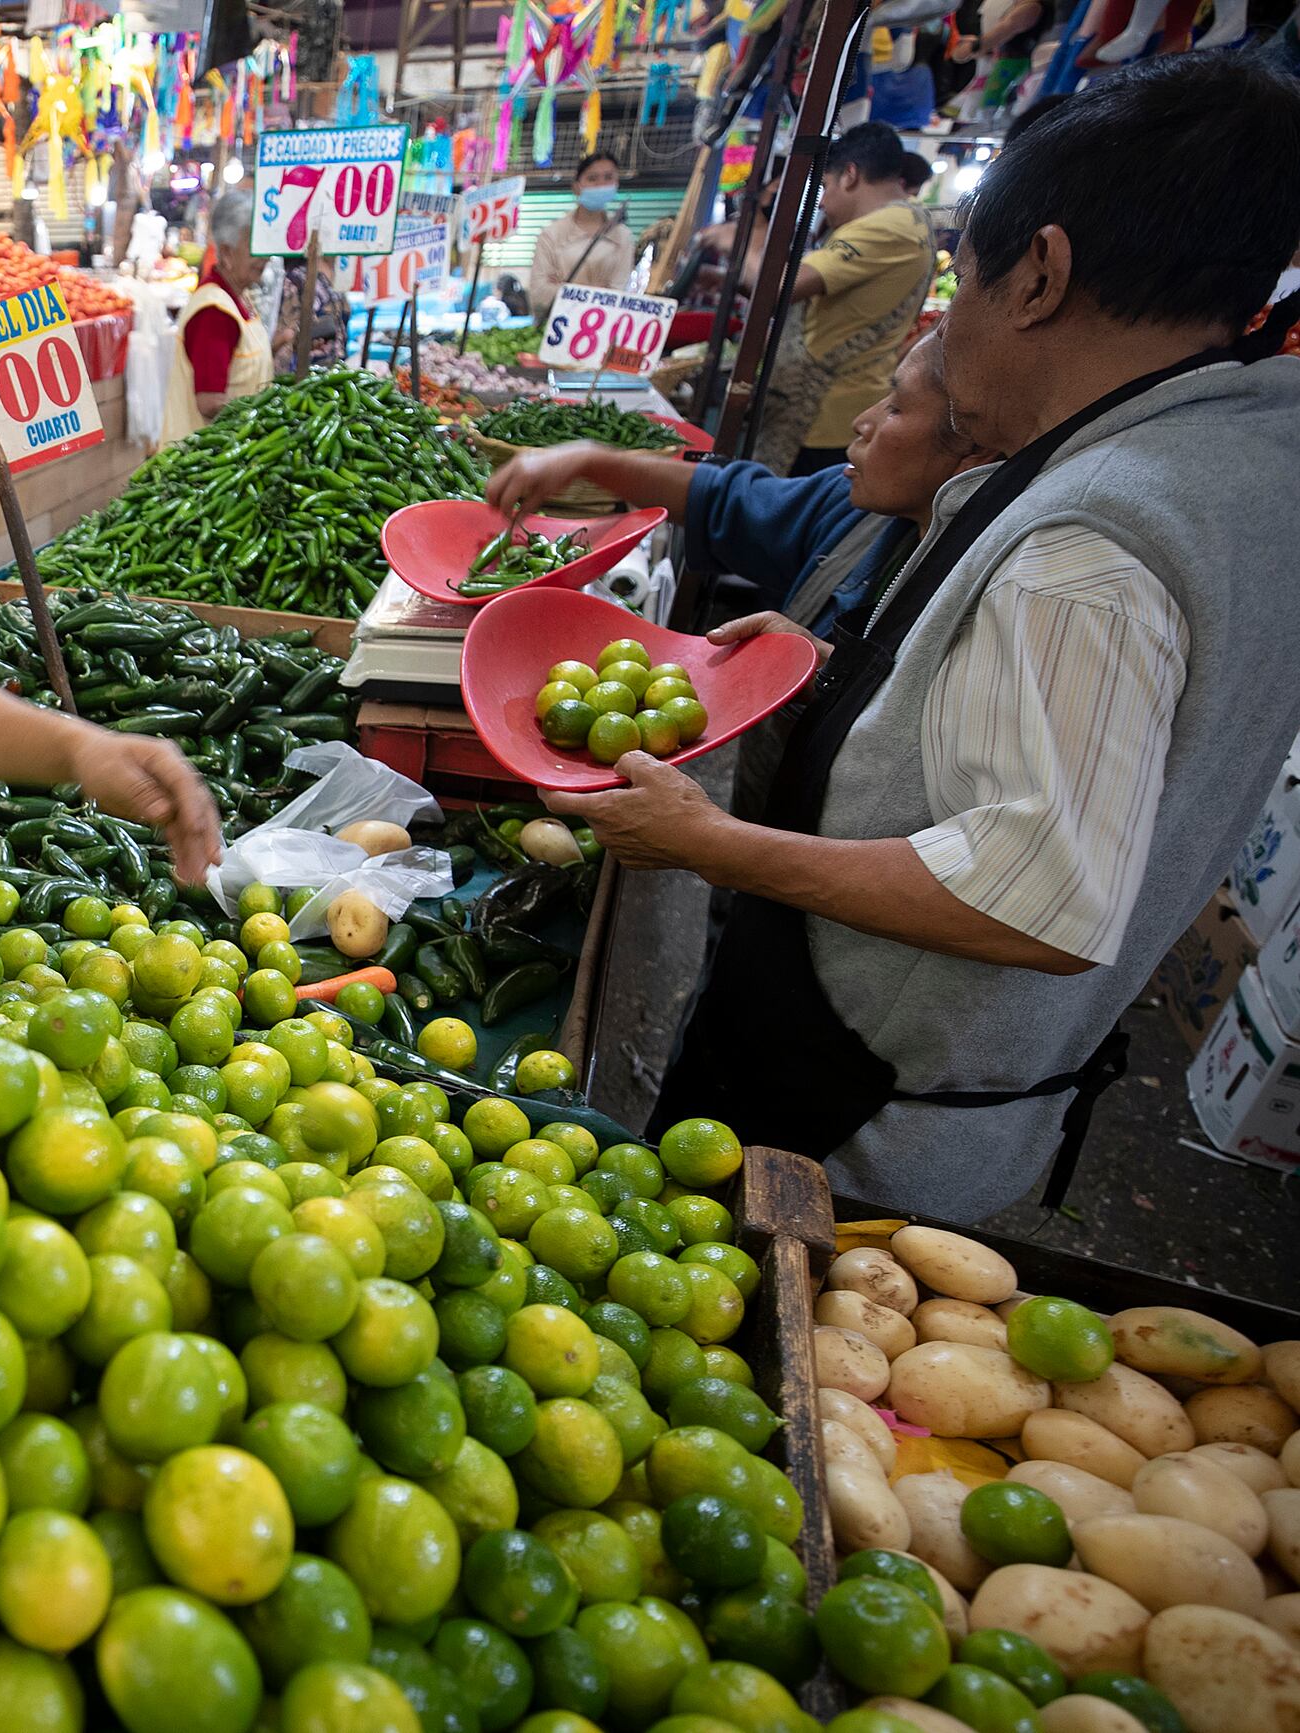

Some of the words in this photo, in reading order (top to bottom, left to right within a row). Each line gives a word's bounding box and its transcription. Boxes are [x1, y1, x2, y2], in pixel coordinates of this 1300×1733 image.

[276, 137, 327, 157] CALIDAD
[331, 136, 340, 154] Y
[344, 133, 388, 153] PRECIO
[339, 223, 378, 243] CUARTO
[18, 284, 67, 333] DIA
[561, 285, 591, 302] MAS
[592, 290, 618, 307] POR
[620, 295, 664, 315] MENOS
[25, 409, 81, 447] CUARTO
